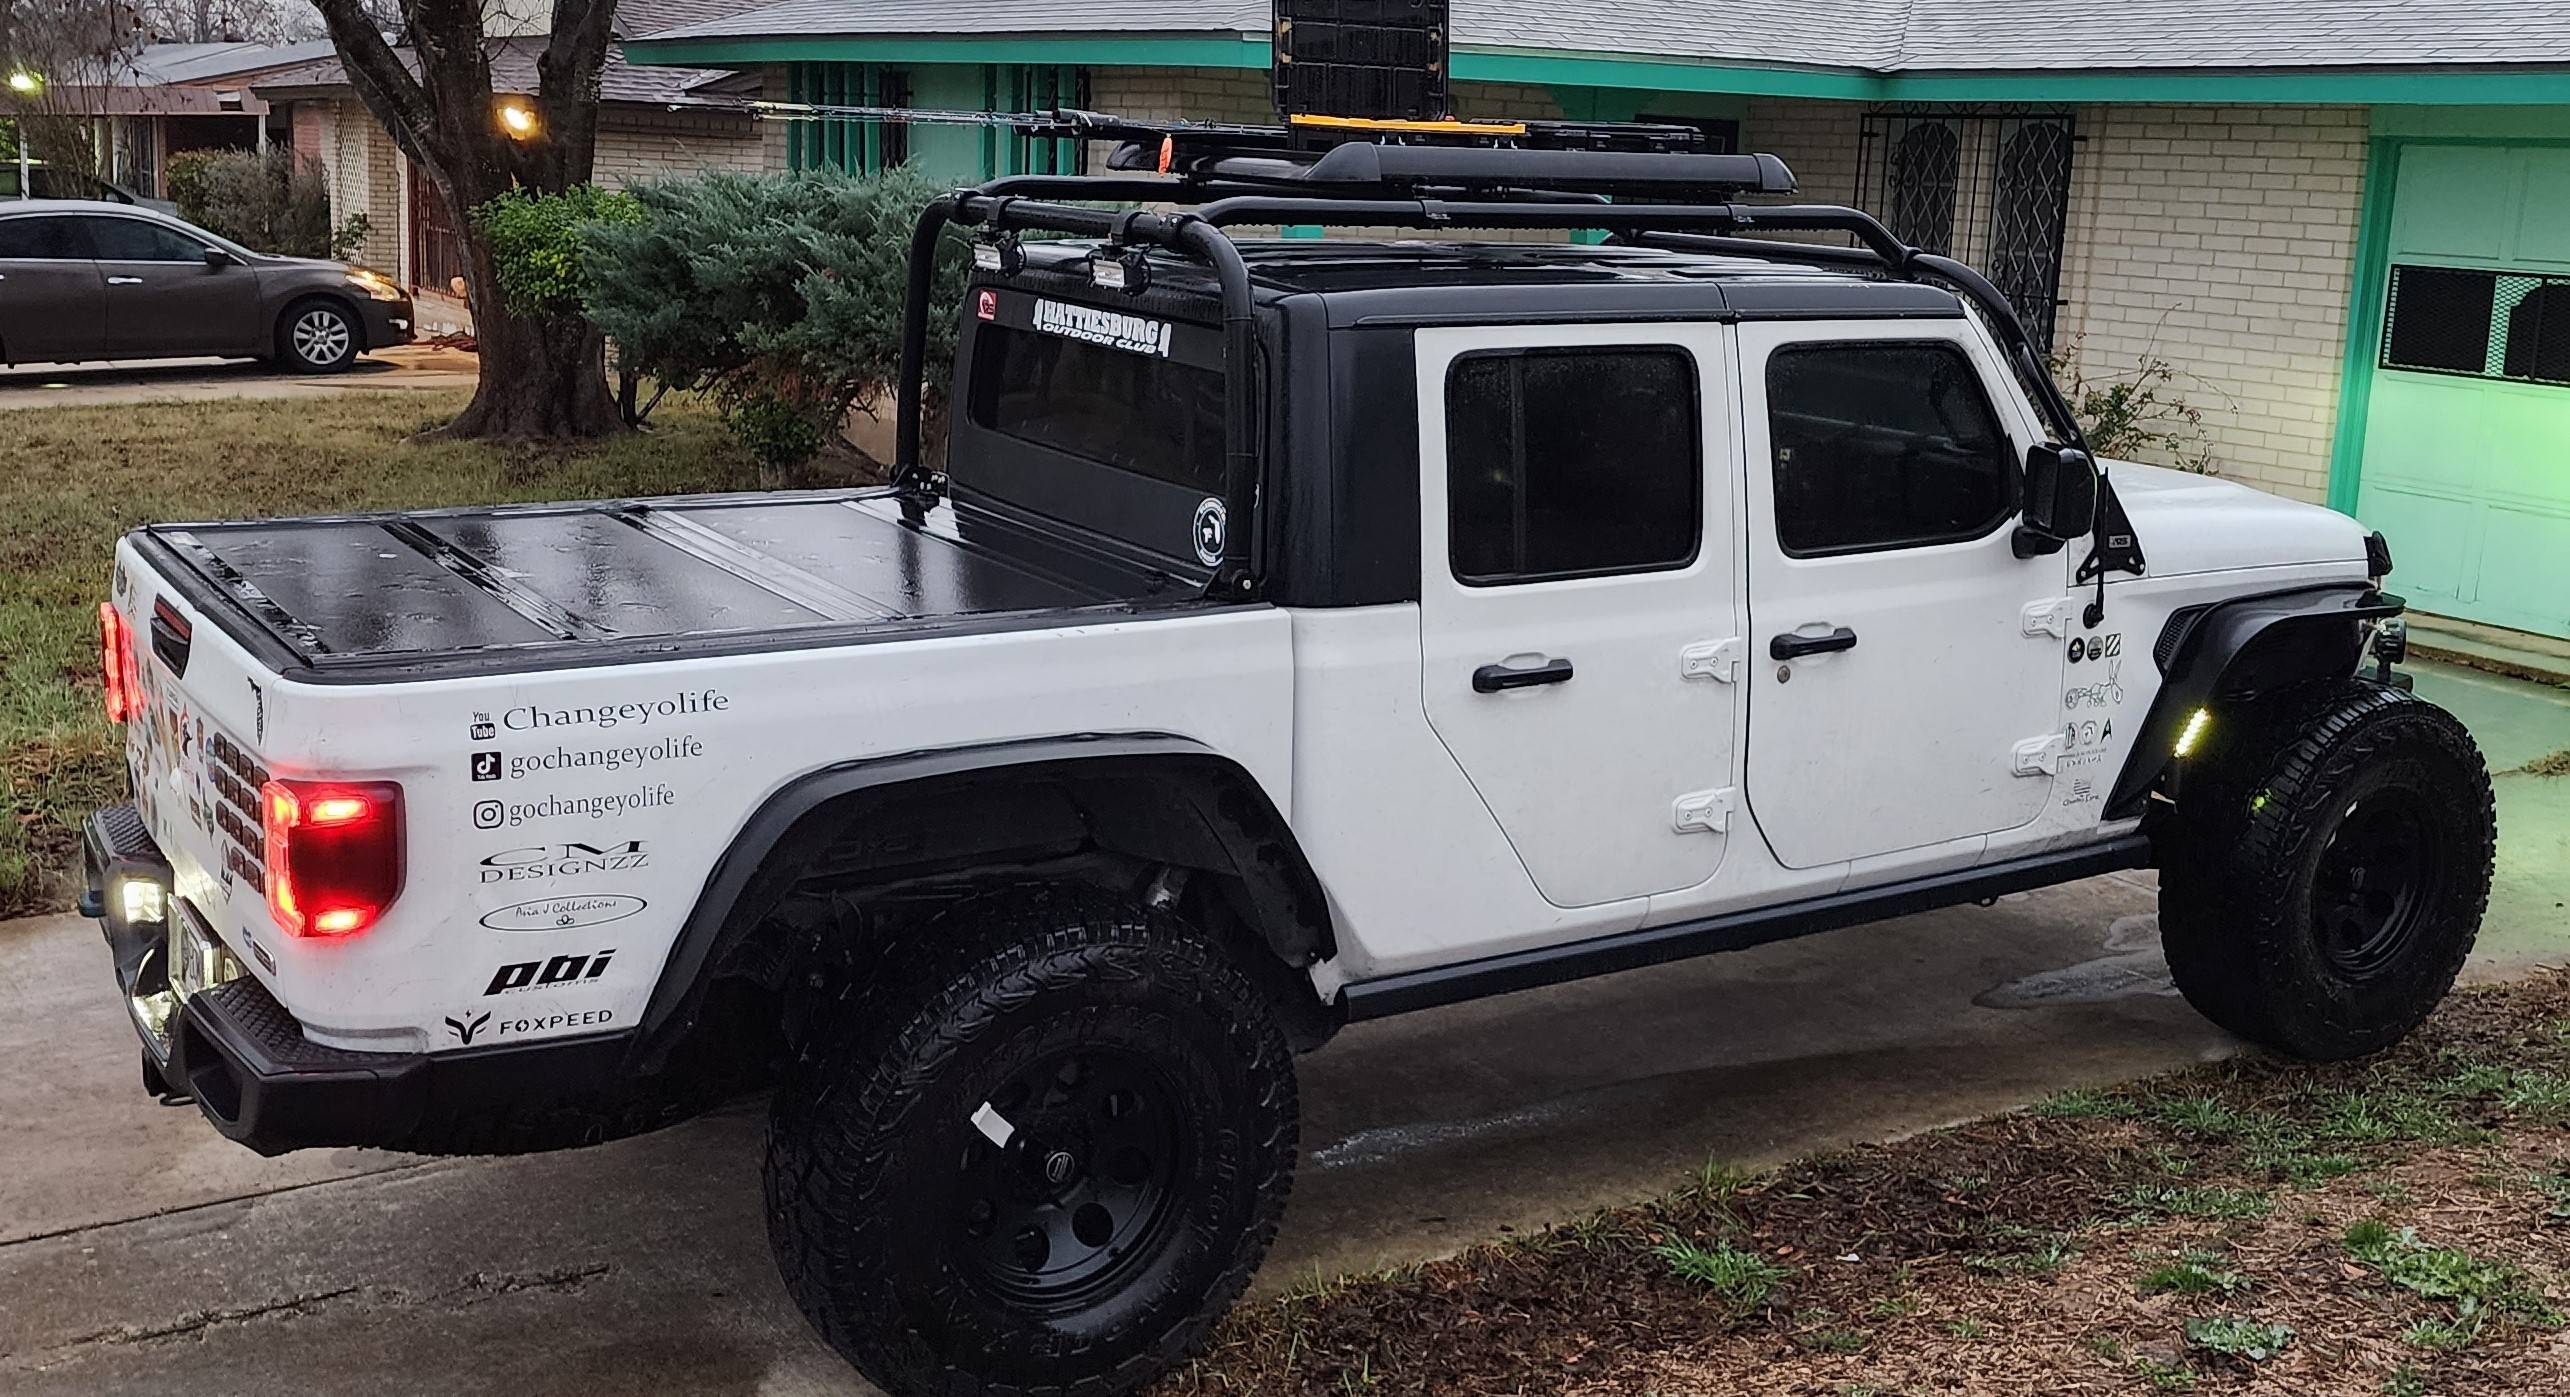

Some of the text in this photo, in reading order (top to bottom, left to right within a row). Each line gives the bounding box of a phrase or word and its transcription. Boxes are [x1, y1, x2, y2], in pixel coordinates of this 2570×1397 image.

[1043, 300, 1159, 344] HATTIESBURG
[1043, 325, 1157, 354] OUTDOOR CLUB
[472, 711, 490, 722] You
[503, 689, 729, 731] Changeyolife
[471, 725, 495, 739] Tube
[510, 735, 703, 779] gochangeyolife
[509, 784, 675, 827] gochangeyolife
[479, 854, 649, 883] DESIGNZZ
[552, 900, 617, 913] Collections
[482, 949, 617, 997] pbi
[500, 1009, 613, 1034] FOXPEED
